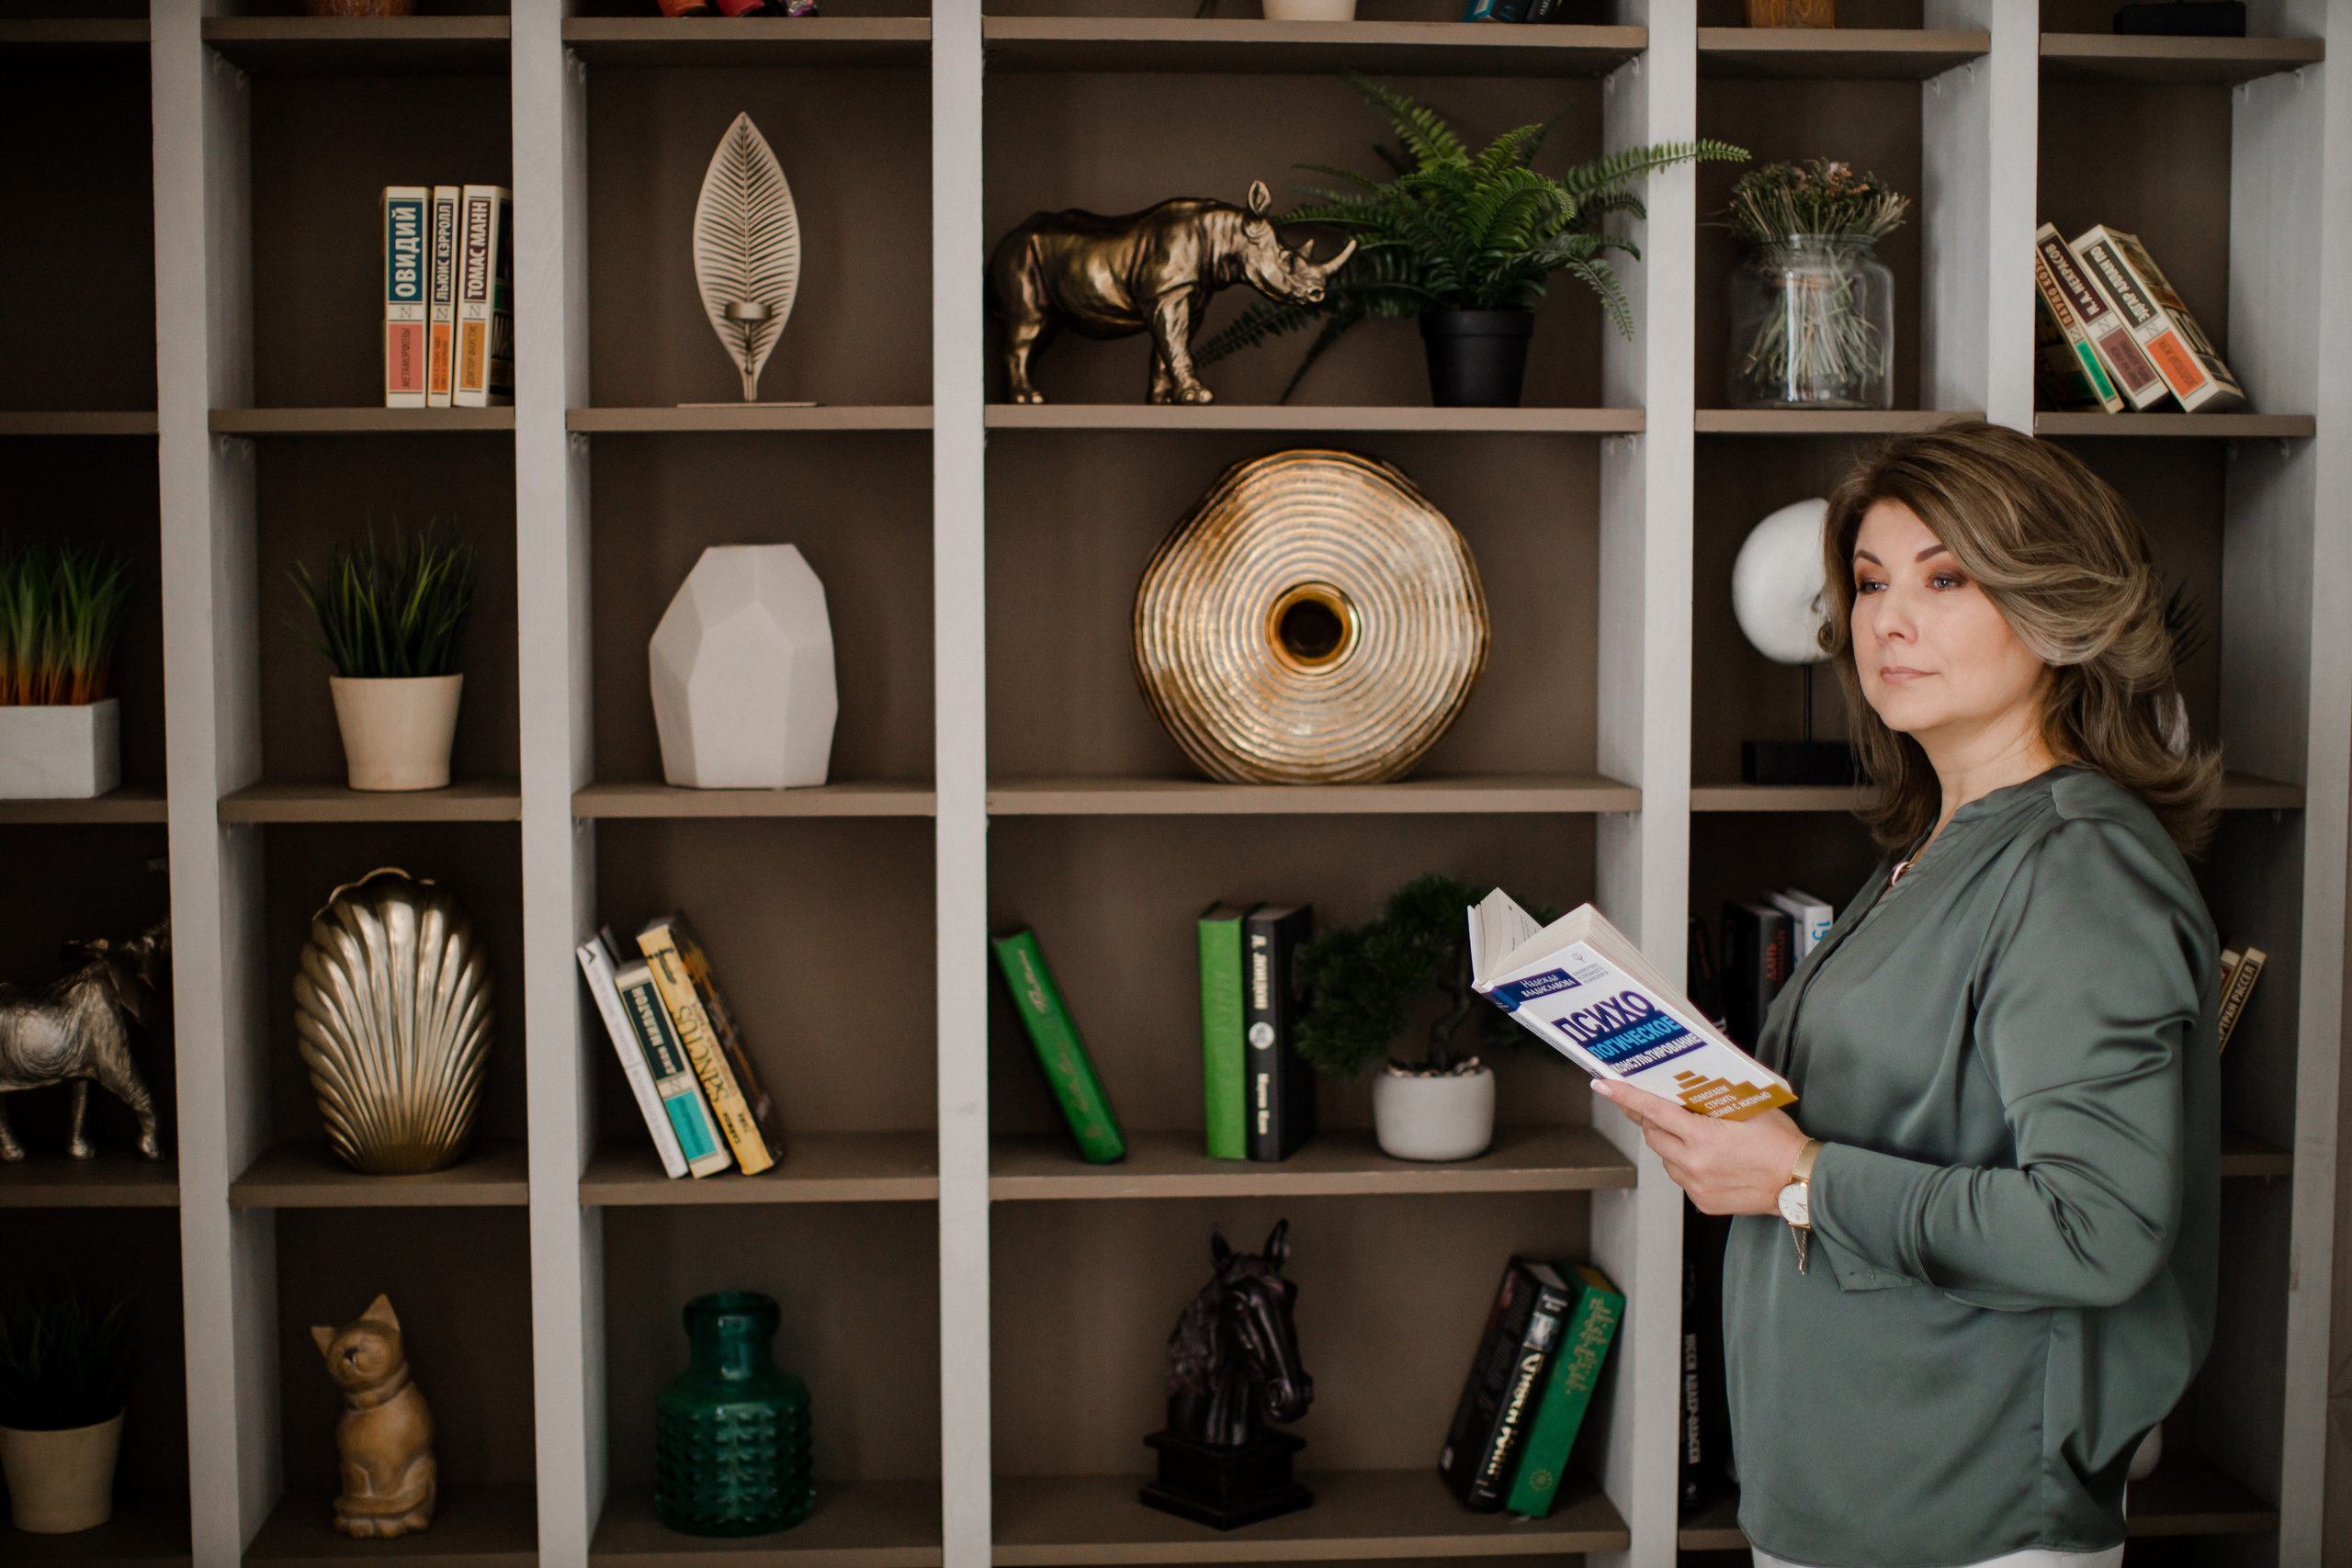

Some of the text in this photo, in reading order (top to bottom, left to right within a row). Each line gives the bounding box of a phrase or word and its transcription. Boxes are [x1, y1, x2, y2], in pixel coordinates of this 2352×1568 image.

[390, 207, 420, 298] ОВИДИЙ
[436, 205, 451, 300] ЛЬЮИС КЭРРОЛЛ
[467, 201, 489, 299] ТОМАС МАНН
[2089, 245, 2108, 265] ПО
[2044, 243, 2086, 295] НЕКРАСОВ
[2099, 259, 2131, 294] АЛЛАН
[2048, 288, 2074, 324] ПАУЛО
[2121, 292, 2151, 323] ЭДГАР
[1252, 952, 1269, 1010] ЛОНДОН
[1520, 974, 1559, 988] Надежда
[1521, 978, 1576, 998] ВЛАДИСЛАВОВА
[2231, 964, 2256, 1003] РАССЕЛ
[631, 986, 664, 1047] МИЛЬТОН
[1551, 990, 1656, 1043] ПСИХО
[1587, 1015, 1683, 1061] ЛОГИЧЕСКОЕ
[1609, 1032, 1703, 1074] КОНСУЛЬТИРОВАНИЕ
[657, 1044, 677, 1075] ДЖОН
[1688, 1085, 1730, 1104] ПОМОГАЕМ
[1703, 1094, 1737, 1110] СТРОИТЬ
[1706, 1091, 1771, 1118] ШЕНИЯ С ЖИЗНЬЮ
